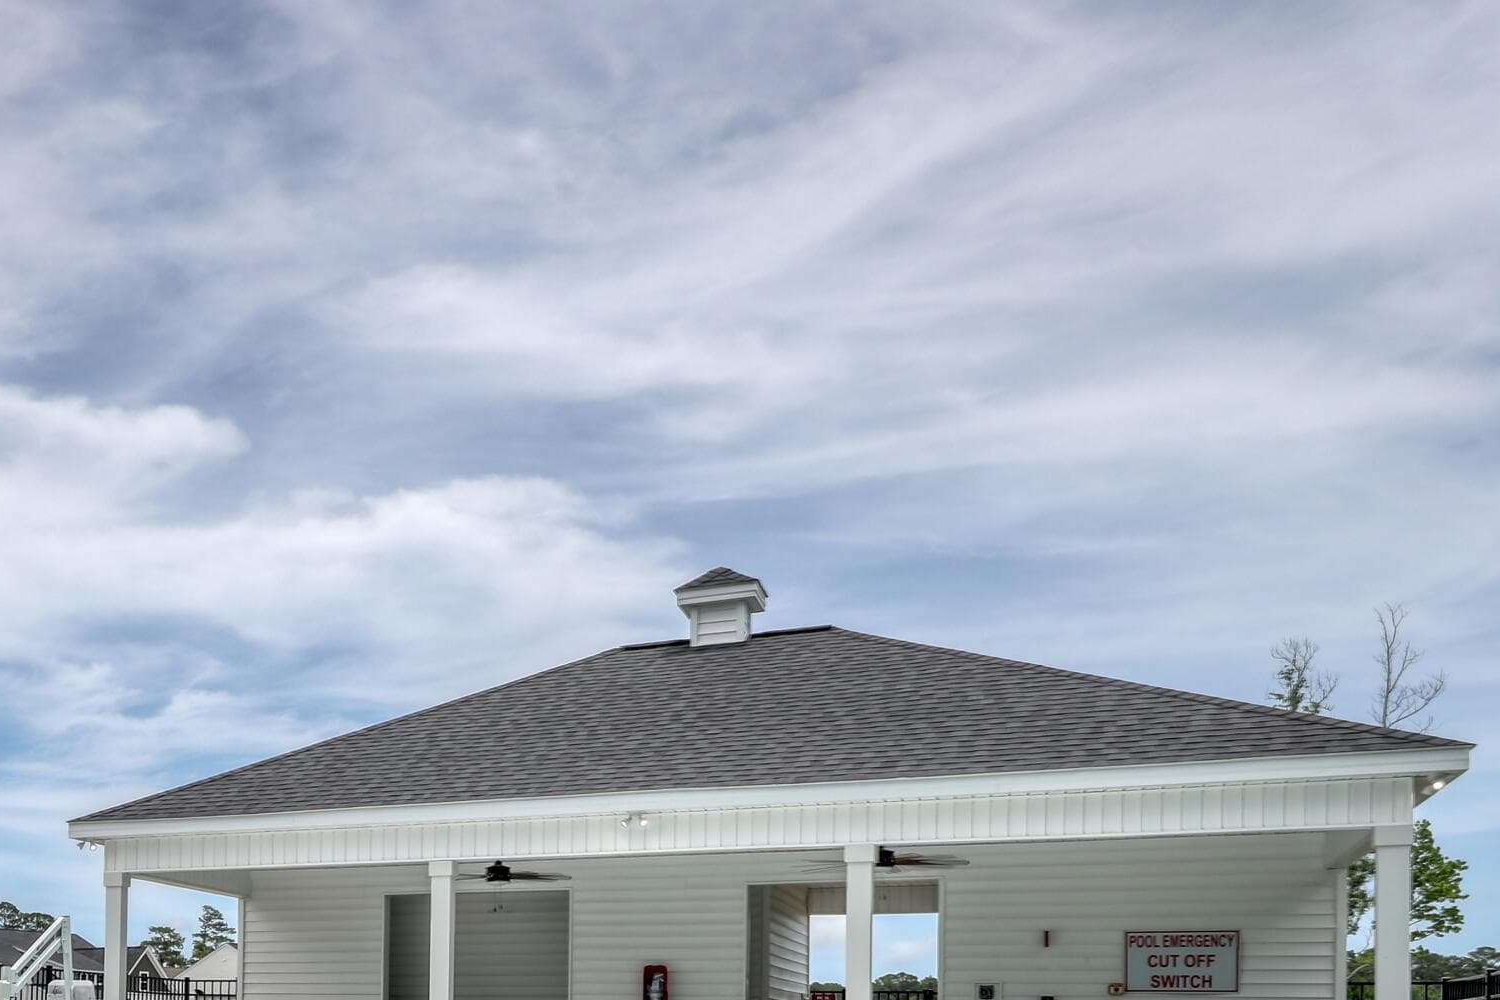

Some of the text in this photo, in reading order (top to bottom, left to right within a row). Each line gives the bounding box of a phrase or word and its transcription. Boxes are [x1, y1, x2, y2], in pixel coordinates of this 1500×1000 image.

[1129, 934, 1235, 948] POOL EMERGENCY
[1147, 954, 1216, 968] CUT OFF
[1150, 975, 1213, 988] SWITCH
